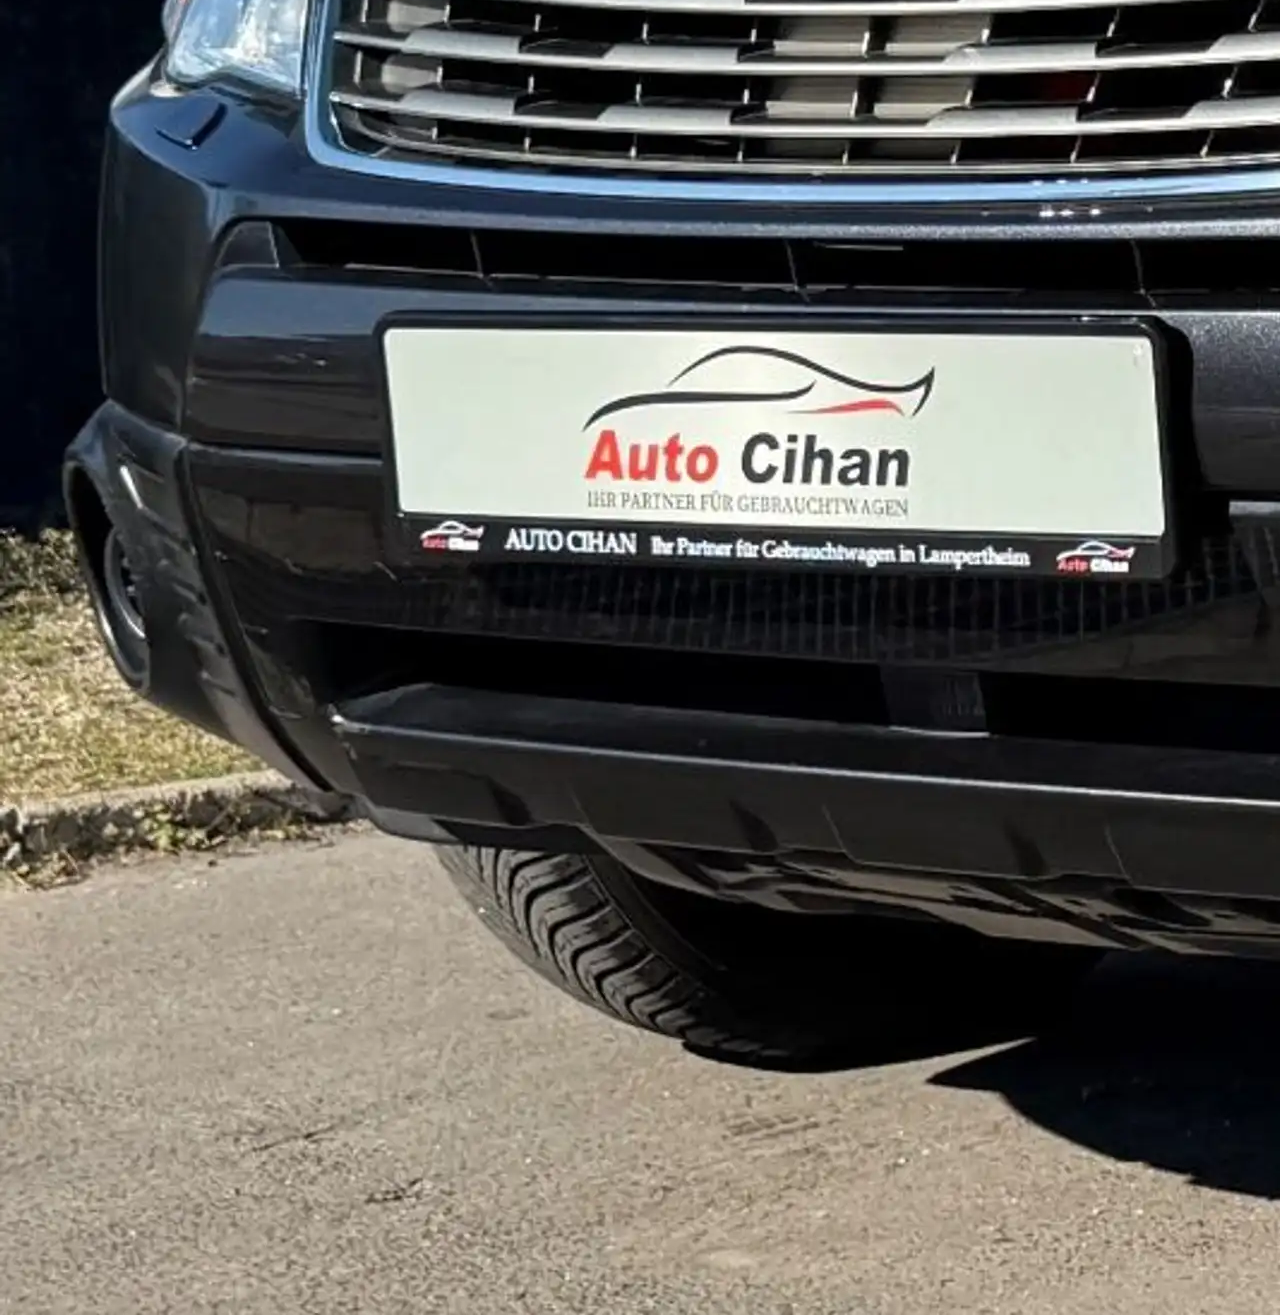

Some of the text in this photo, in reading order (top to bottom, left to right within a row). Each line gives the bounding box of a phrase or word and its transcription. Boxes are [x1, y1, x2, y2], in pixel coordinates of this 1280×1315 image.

[584, 429, 910, 488] Auto Cihan
[587, 489, 909, 518] IHR PARTNER FÜR GEBRAUCHTWAGEN
[504, 528, 562, 552] AUTO
[566, 530, 637, 555] CIHAN
[677, 536, 733, 558] Partner
[735, 537, 758, 558] für
[761, 539, 897, 568] Gebrauchtwagen
[900, 543, 916, 564] in
[918, 543, 1031, 571] Lampertheim
